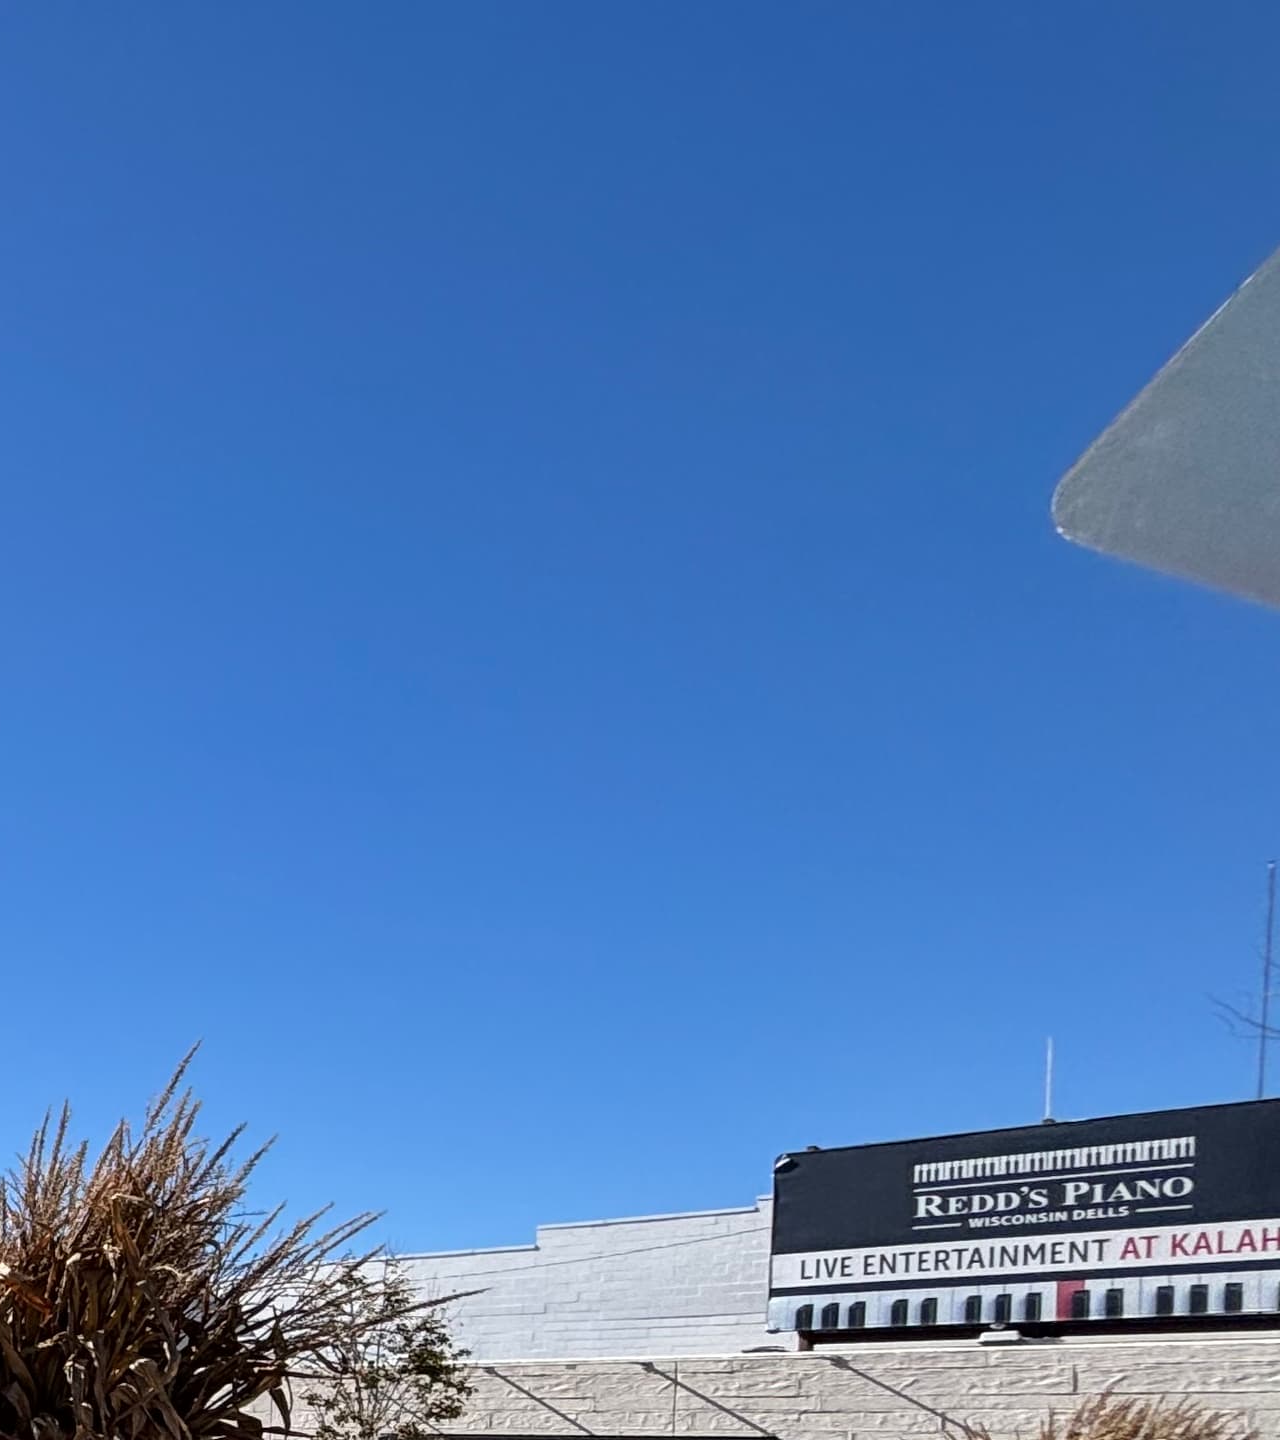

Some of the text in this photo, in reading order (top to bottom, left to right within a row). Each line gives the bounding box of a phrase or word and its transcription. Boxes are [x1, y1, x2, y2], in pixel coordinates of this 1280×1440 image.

[914, 1176, 1195, 1218] REDD'S PIANO
[968, 1206, 1130, 1228] WISCONSIN DELLS
[800, 1227, 1280, 1280] LIVE ENTERTAINMENT AT KALAH
